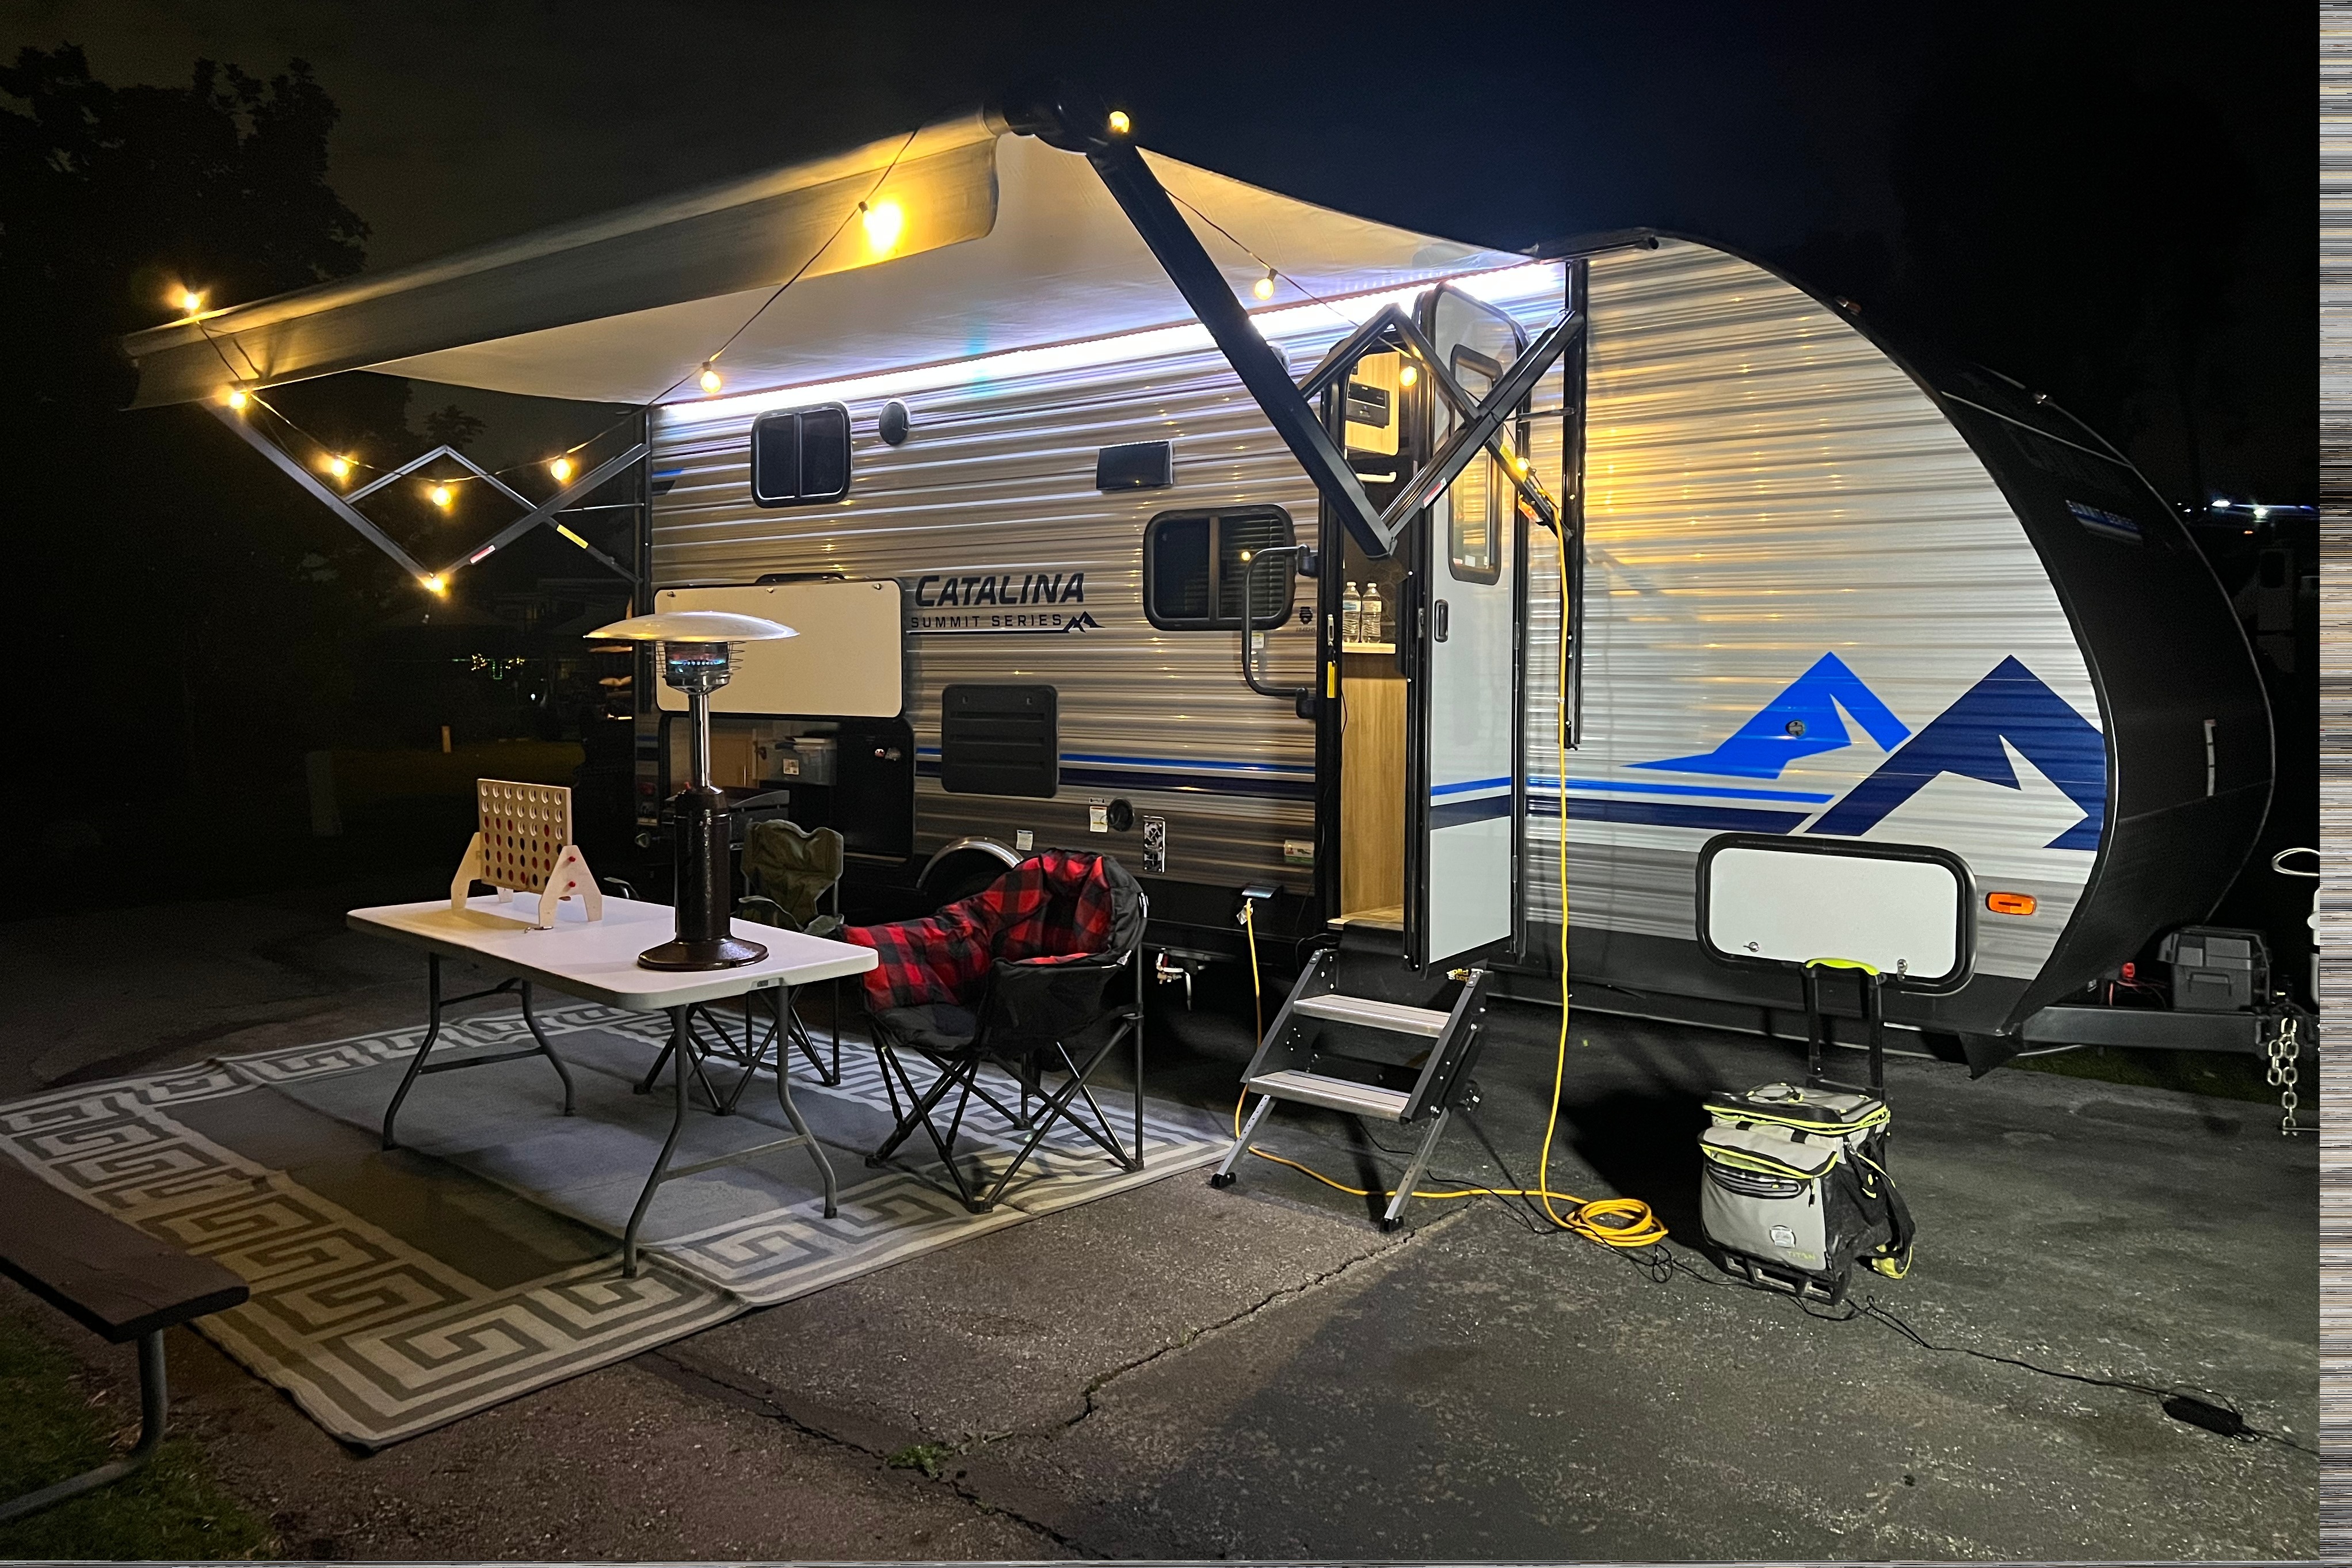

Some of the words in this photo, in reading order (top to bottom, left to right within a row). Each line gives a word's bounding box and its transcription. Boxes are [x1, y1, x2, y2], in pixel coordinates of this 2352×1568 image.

[915, 572, 1084, 606] CATALINA
[911, 616, 980, 628] SUMMIT
[992, 614, 1061, 627] SERIES
[1786, 1250, 1816, 1261] TITAN
